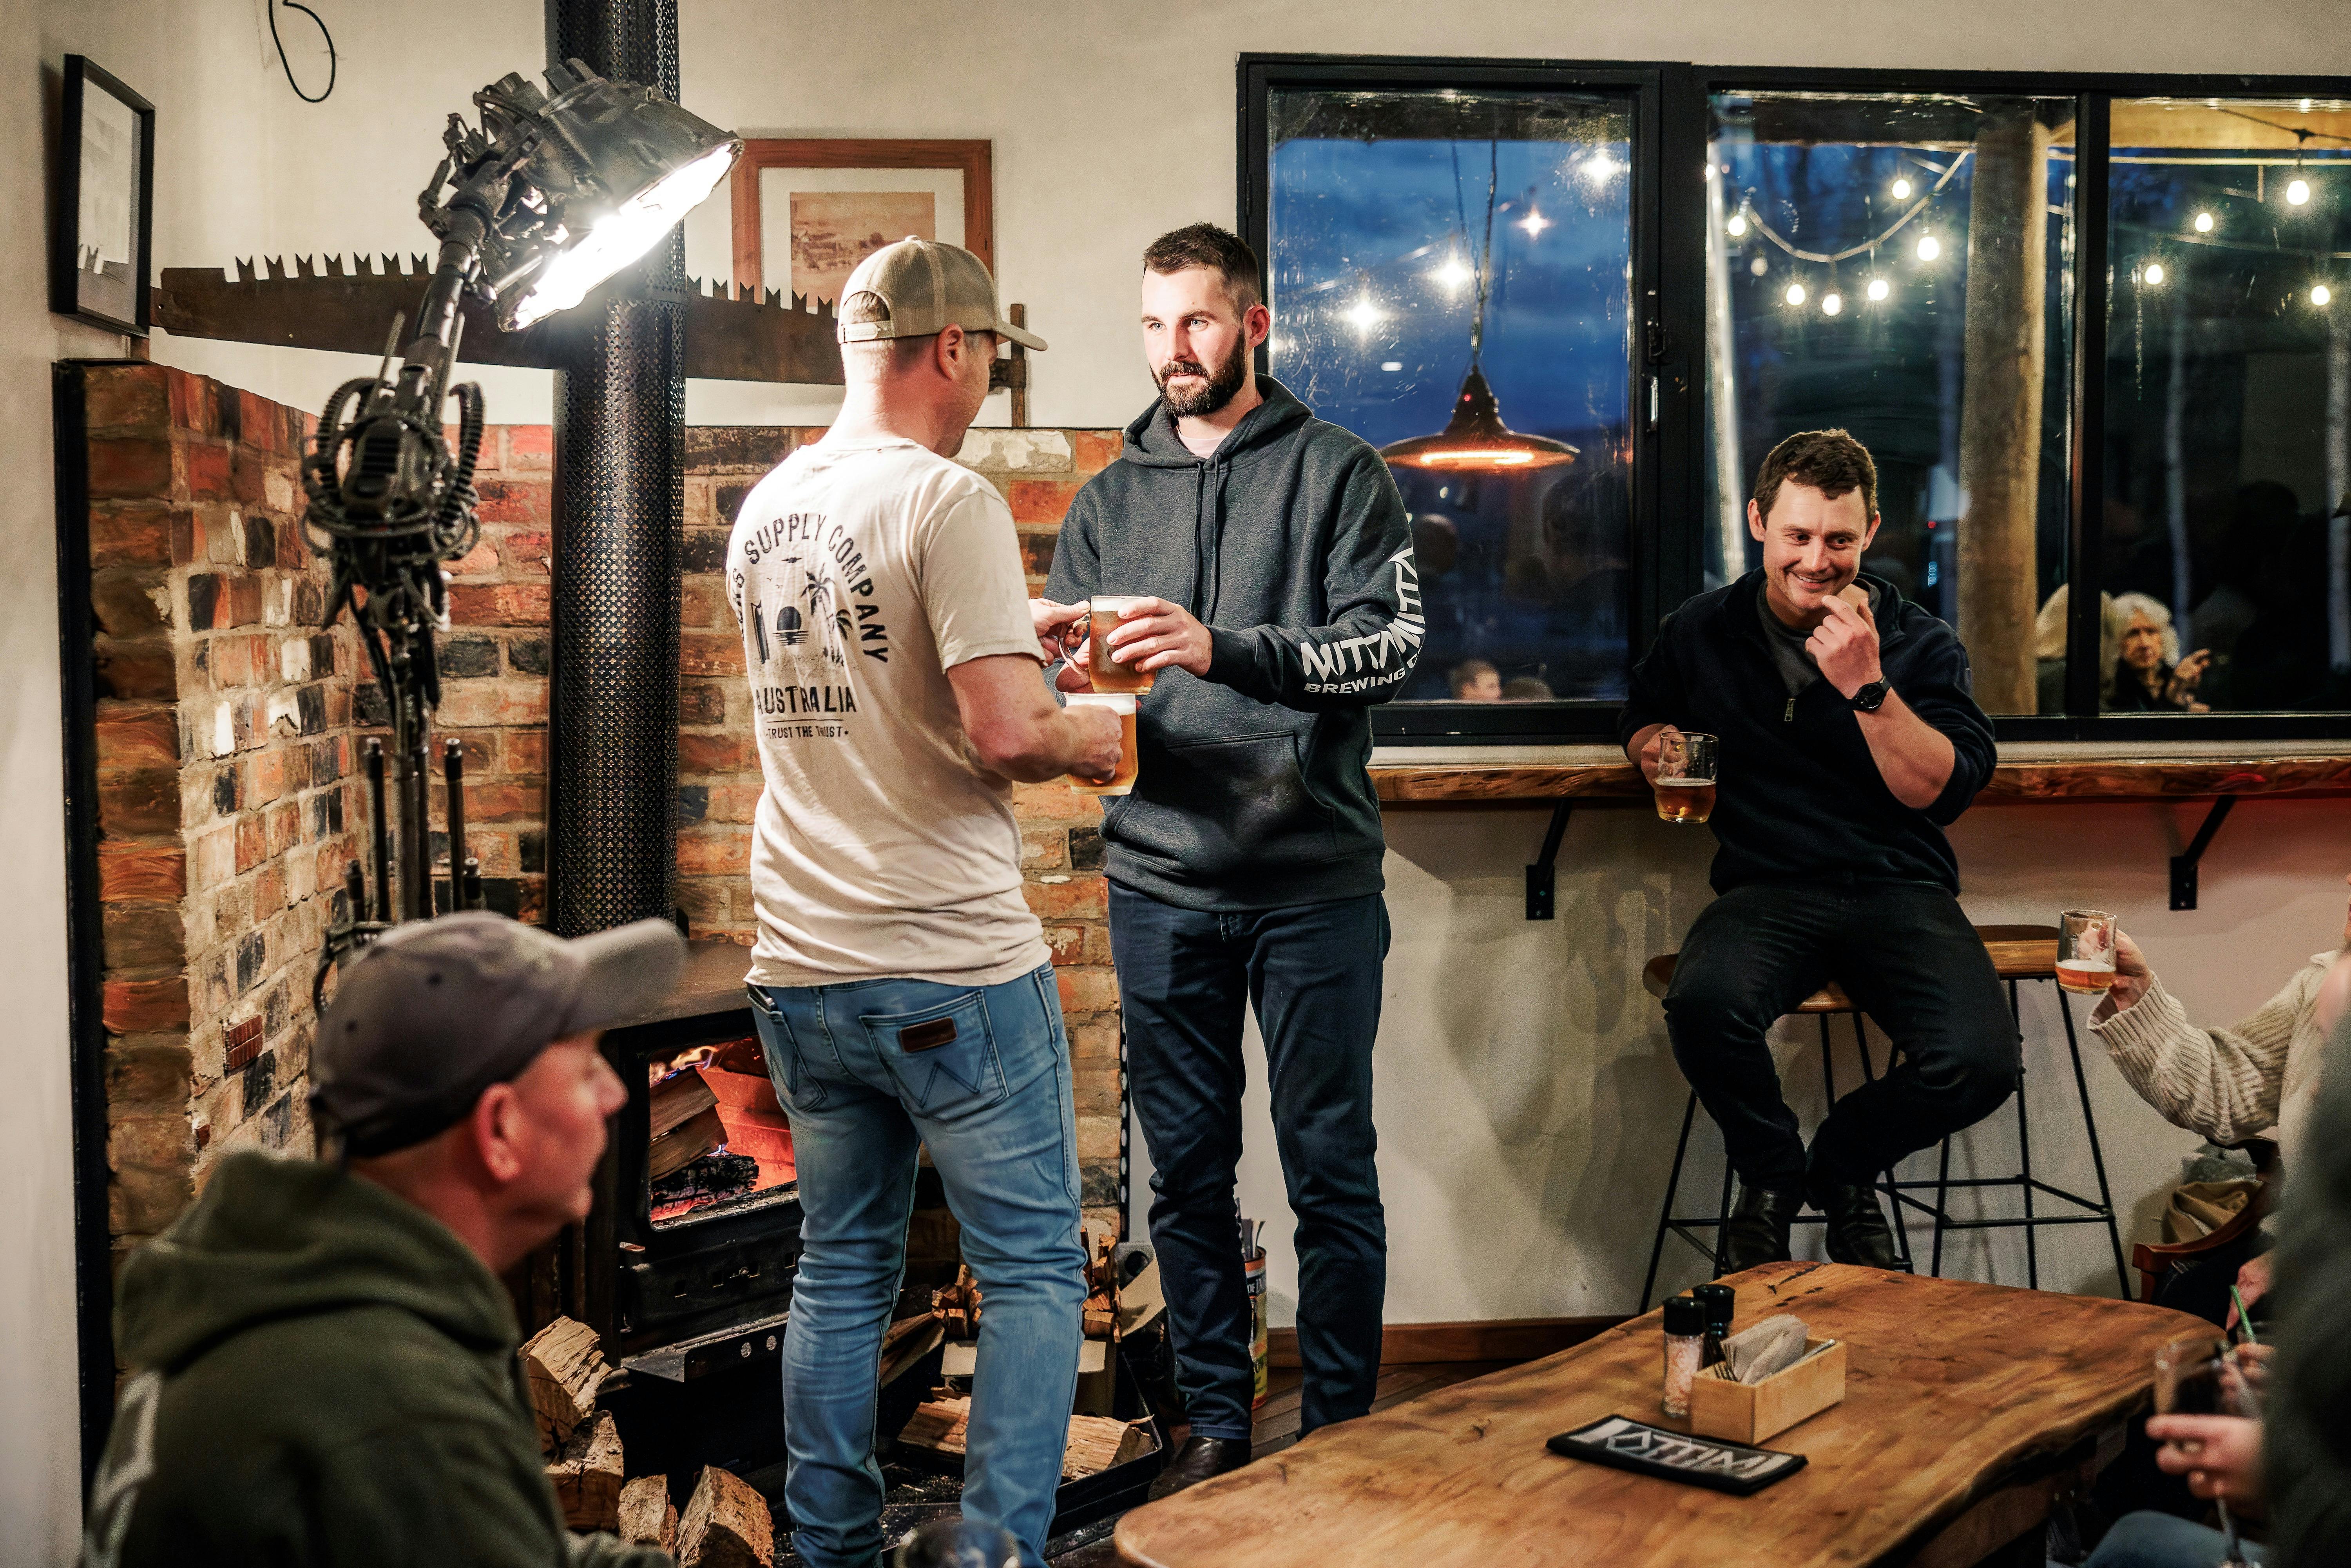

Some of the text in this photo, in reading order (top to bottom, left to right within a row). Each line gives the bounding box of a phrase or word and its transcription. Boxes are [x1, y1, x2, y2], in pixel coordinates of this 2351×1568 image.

[744, 513, 827, 565] SUPPLY
[828, 524, 889, 663] COMPANY
[1304, 667, 1406, 693] BREWING
[755, 685, 857, 714] AUSTRALIA
[768, 727, 793, 739] TRUST
[795, 725, 813, 738] THE
